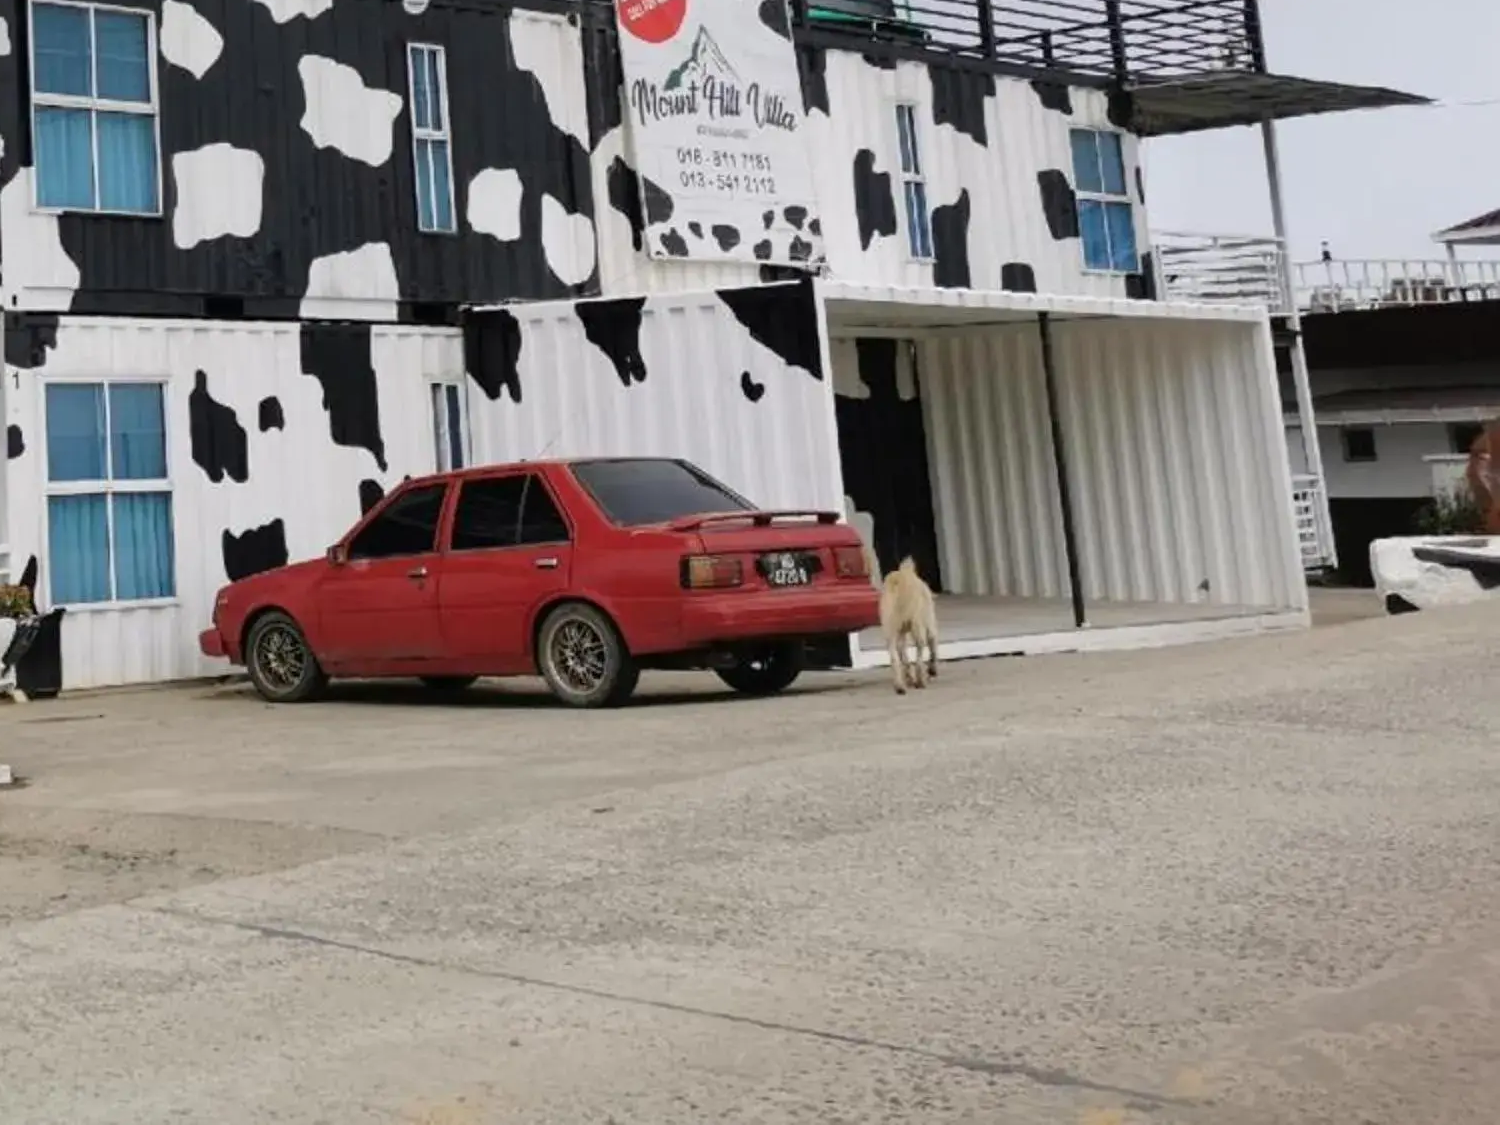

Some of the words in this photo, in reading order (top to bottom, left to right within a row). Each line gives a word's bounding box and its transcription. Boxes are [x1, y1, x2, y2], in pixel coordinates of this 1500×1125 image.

[631, 78, 699, 126] Mount
[703, 75, 741, 120] Hill
[746, 82, 798, 132] Villa
